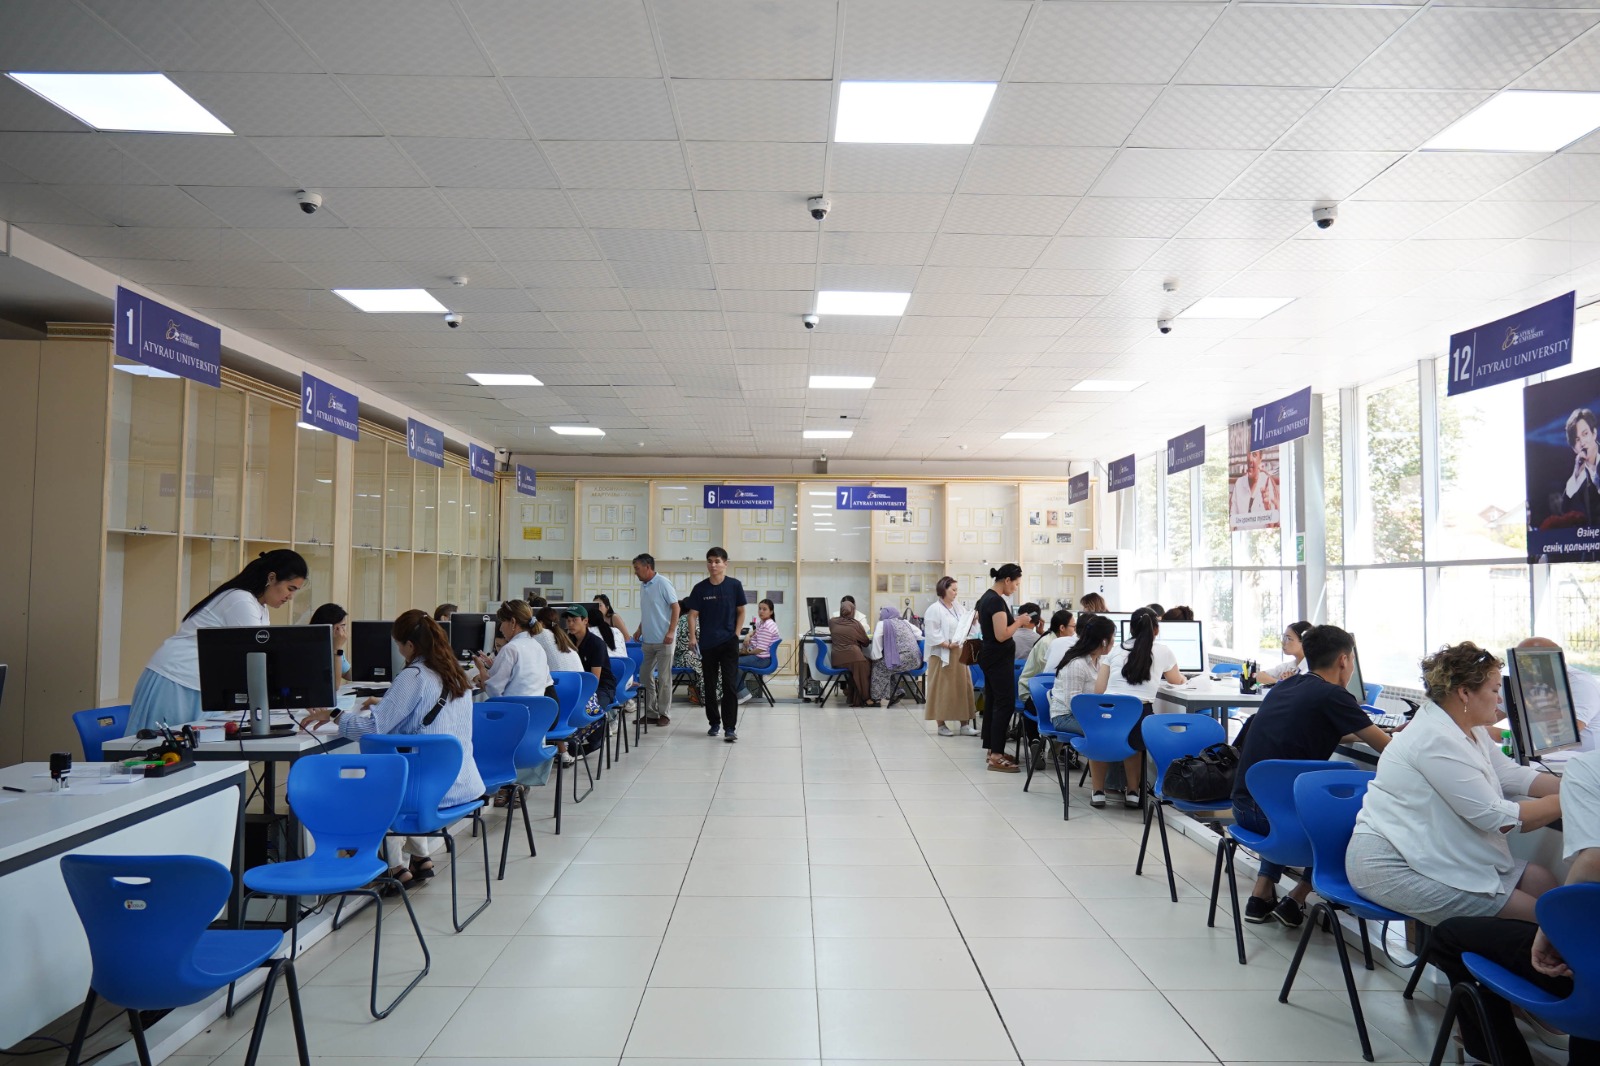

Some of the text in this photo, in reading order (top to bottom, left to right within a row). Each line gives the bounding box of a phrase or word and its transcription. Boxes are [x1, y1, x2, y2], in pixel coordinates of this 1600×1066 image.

[126, 308, 134, 345] 1
[143, 341, 219, 375] ATYRAU UNIVERSITY
[1453, 345, 1472, 382] 12
[1476, 339, 1570, 377] ATYRAU UNIVERSITY
[306, 386, 313, 415] 2
[316, 409, 358, 432] ATYRAU UNIVERSITY
[1254, 416, 1264, 442] 11
[1265, 417, 1309, 439] ATYRAU UNIVERSITY
[410, 428, 415, 450] 3
[1168, 447, 1175, 468] 10
[708, 490, 716, 504] 6
[841, 491, 848, 506] 7
[1577, 526, 1599, 538] Өзіңе
[1543, 542, 1563, 554] сенің
